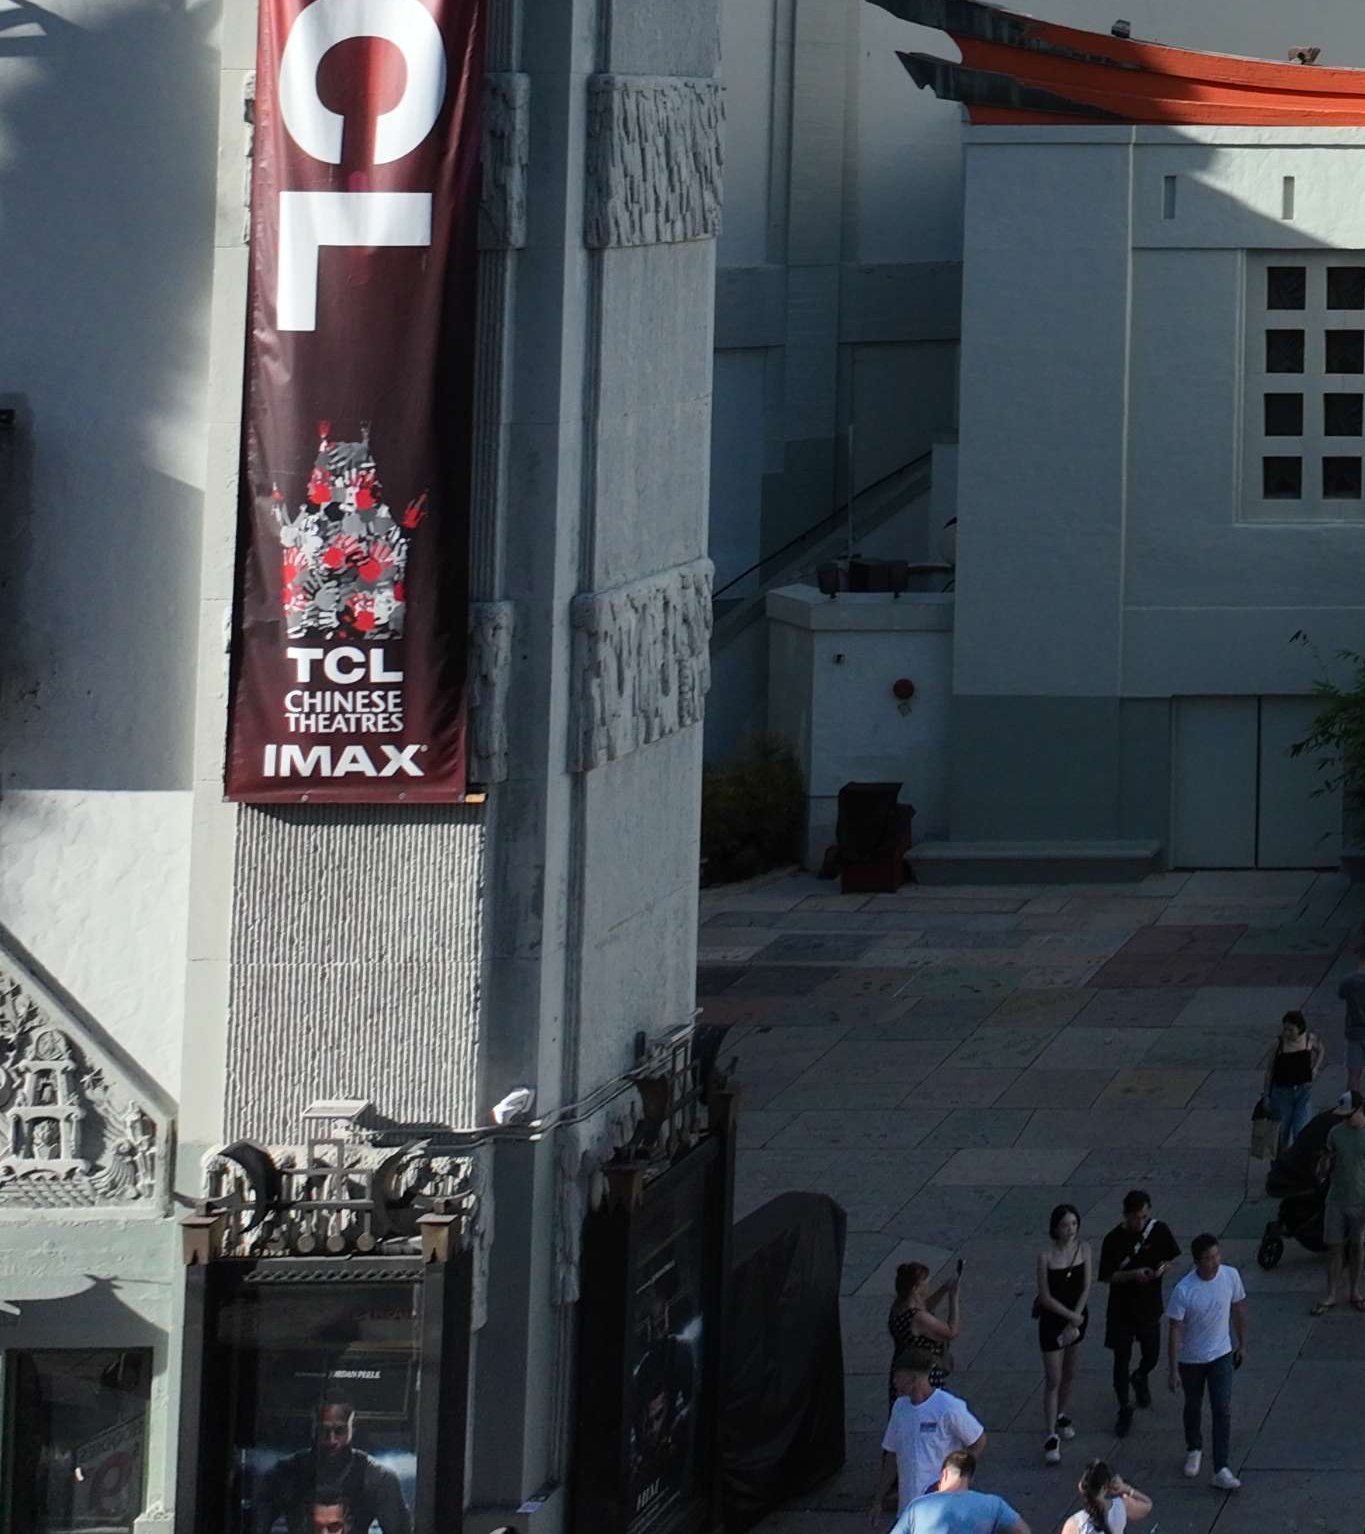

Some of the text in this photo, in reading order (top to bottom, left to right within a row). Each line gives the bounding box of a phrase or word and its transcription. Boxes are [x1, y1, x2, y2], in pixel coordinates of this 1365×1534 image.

[286, 646, 404, 684] TCL
[284, 689, 403, 713] CHINESE
[284, 712, 404, 733] THEATRES
[263, 744, 425, 777] IMAX
